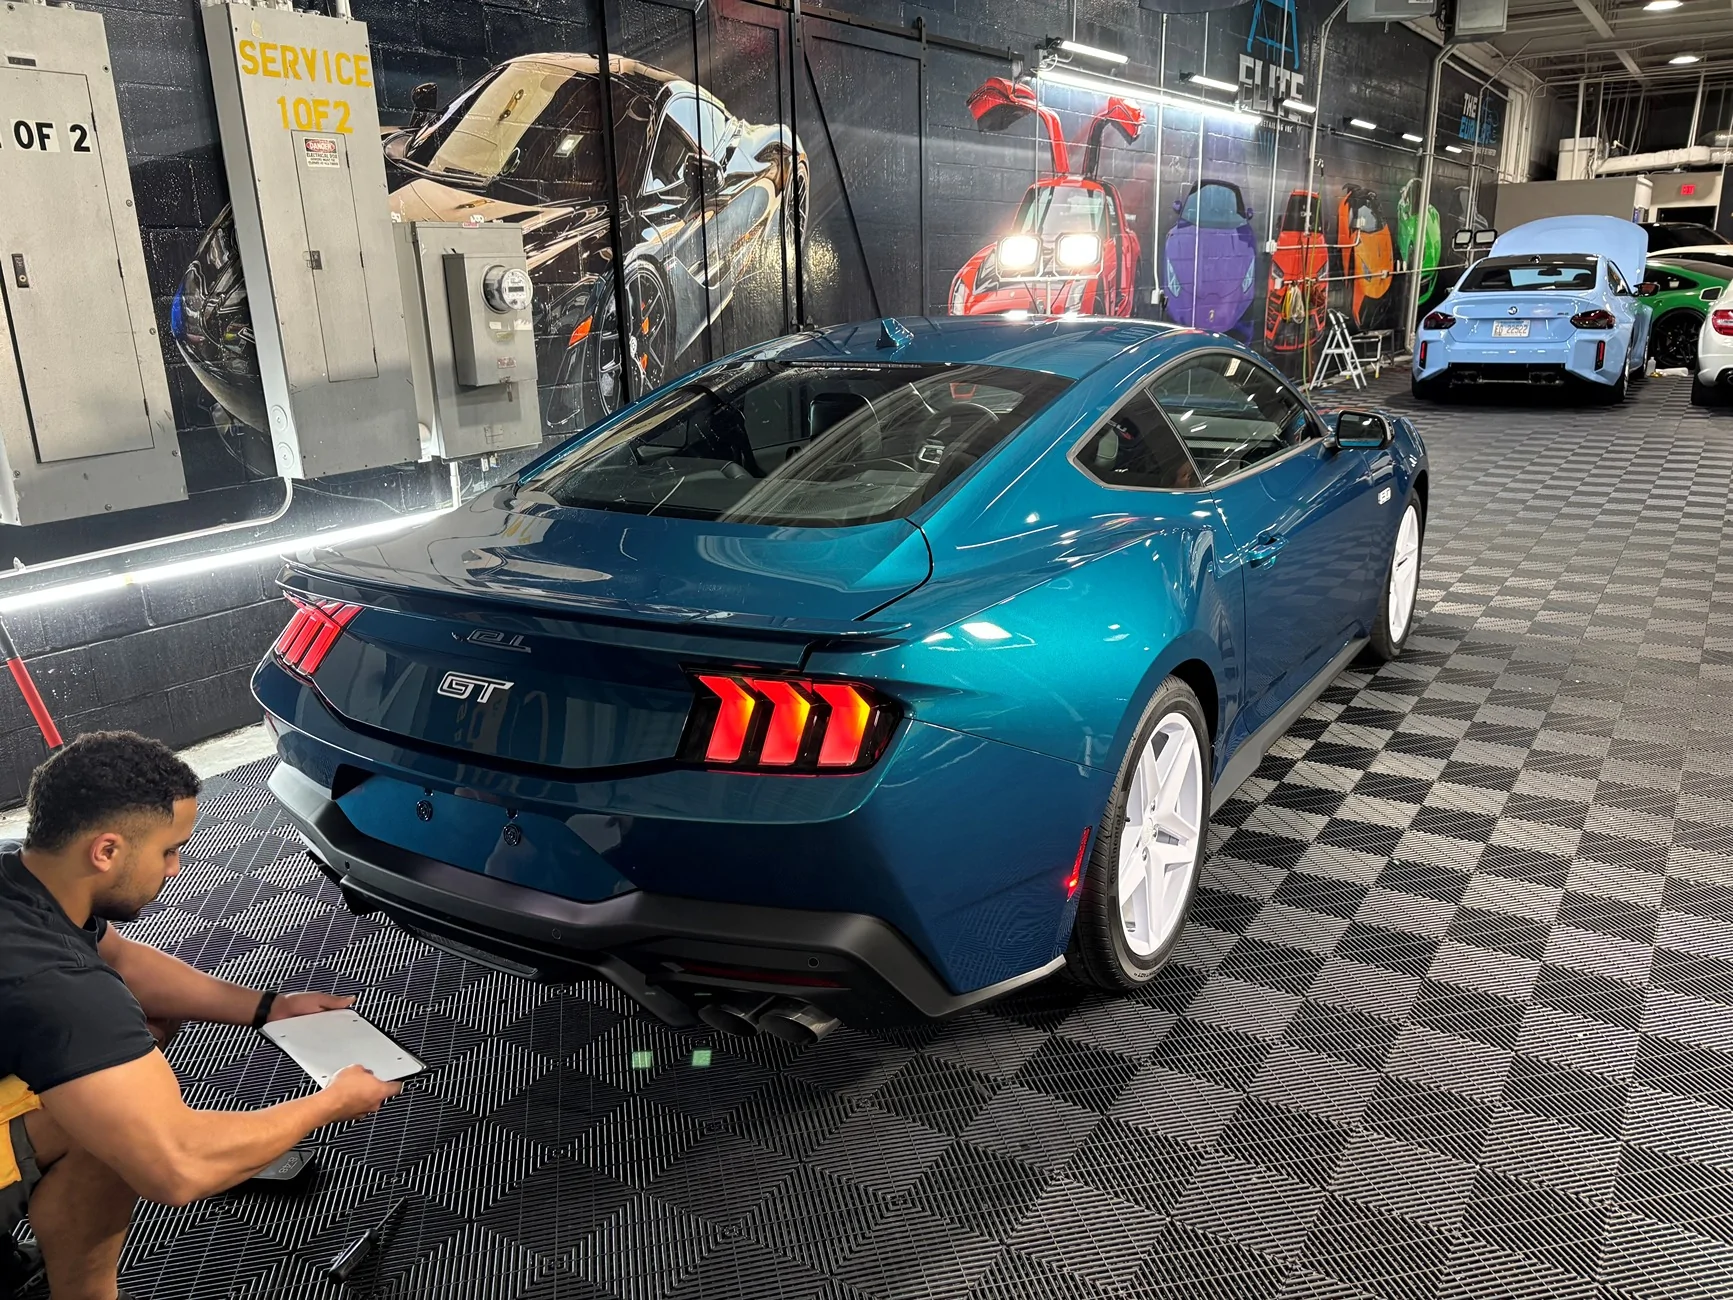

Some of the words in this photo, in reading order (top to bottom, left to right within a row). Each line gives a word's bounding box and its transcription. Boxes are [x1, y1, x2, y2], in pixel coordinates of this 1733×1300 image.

[239, 39, 373, 88] SERVICE
[1463, 92, 1478, 118] THE
[13, 120, 53, 151] OF
[69, 124, 91, 152] 2
[437, 671, 515, 704] GT
